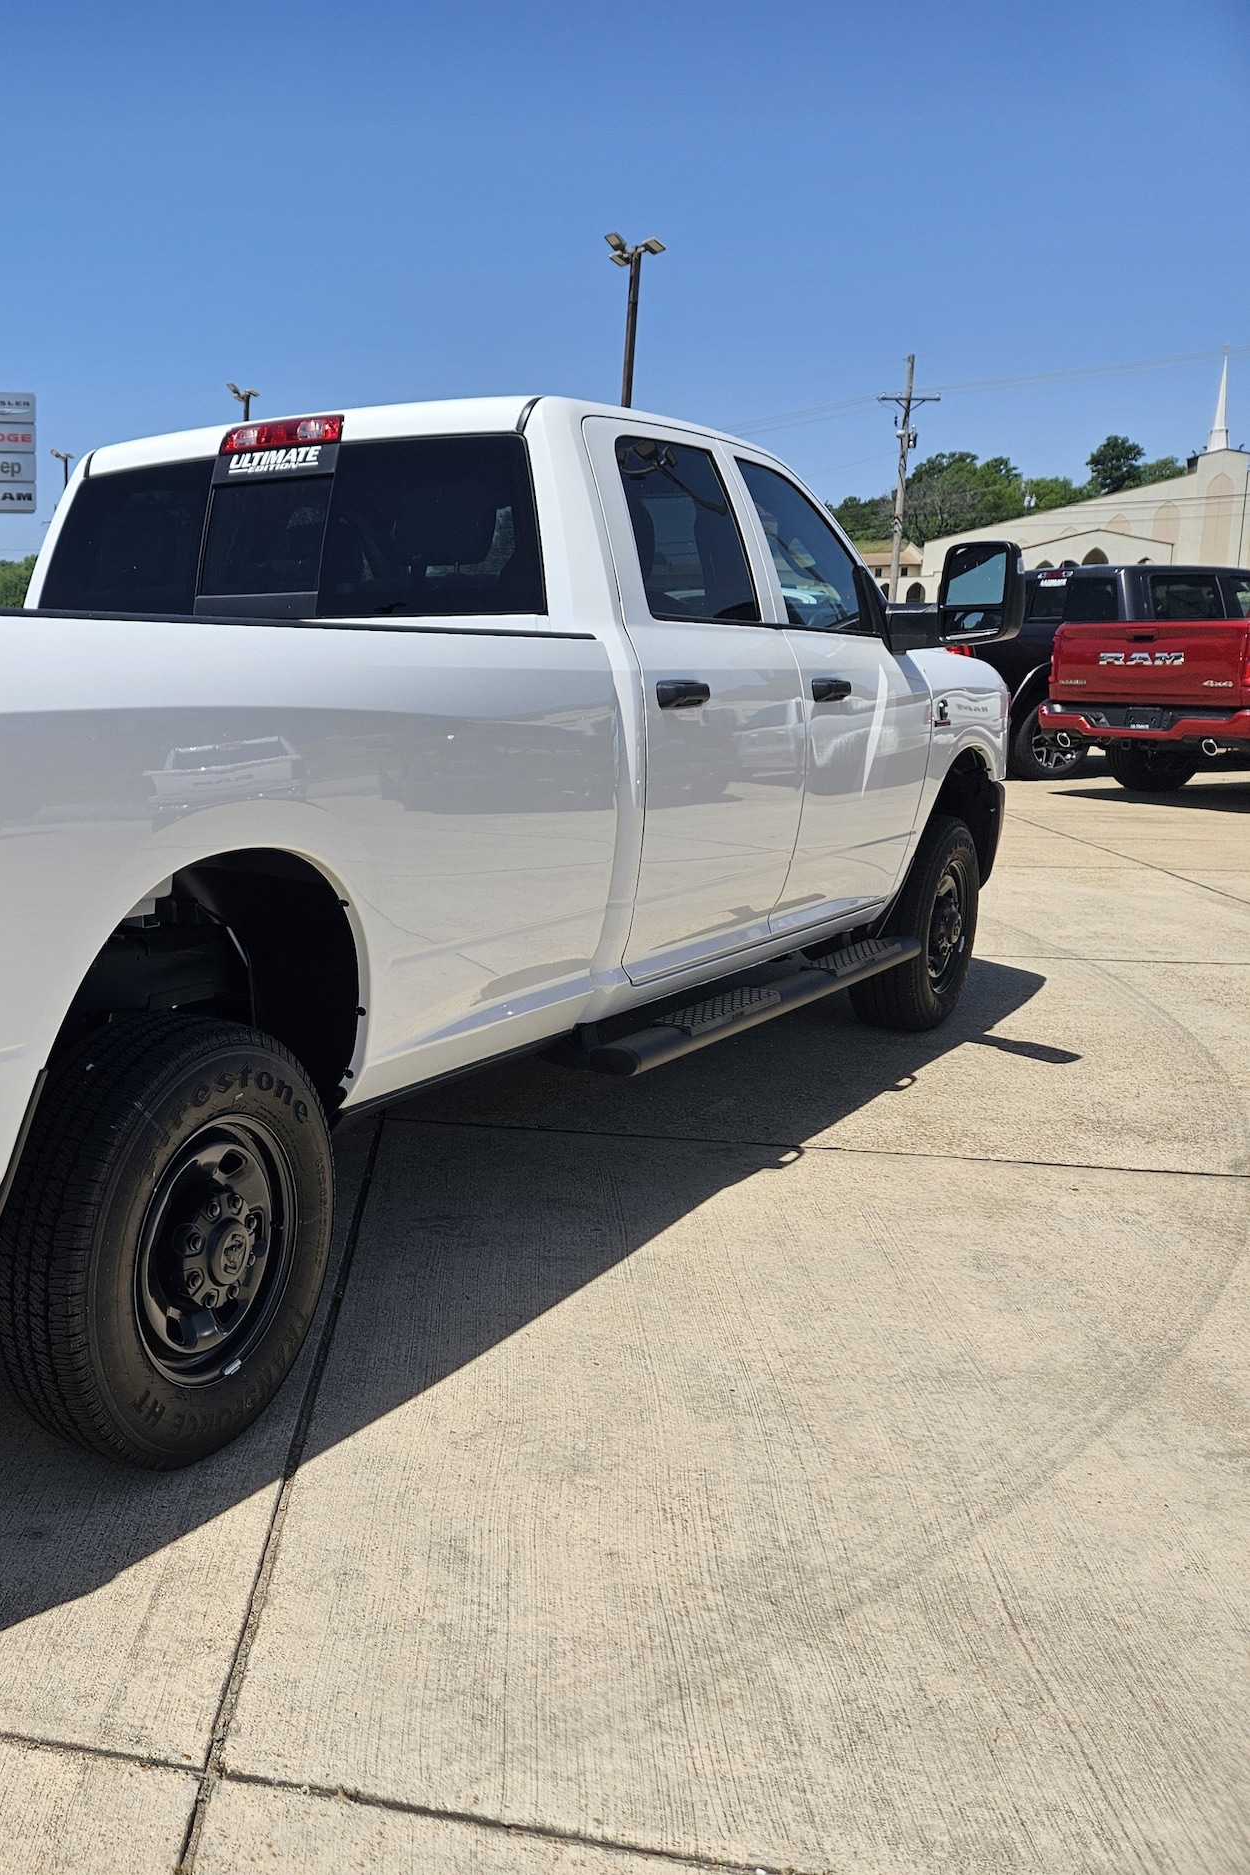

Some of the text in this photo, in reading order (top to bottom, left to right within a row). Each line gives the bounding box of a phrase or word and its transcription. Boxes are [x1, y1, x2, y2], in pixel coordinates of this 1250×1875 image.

[229, 445, 321, 470] ULTIMATE
[247, 462, 299, 473] EDITION
[1098, 652, 1185, 666] RAM
[130, 1387, 166, 1428] HT
